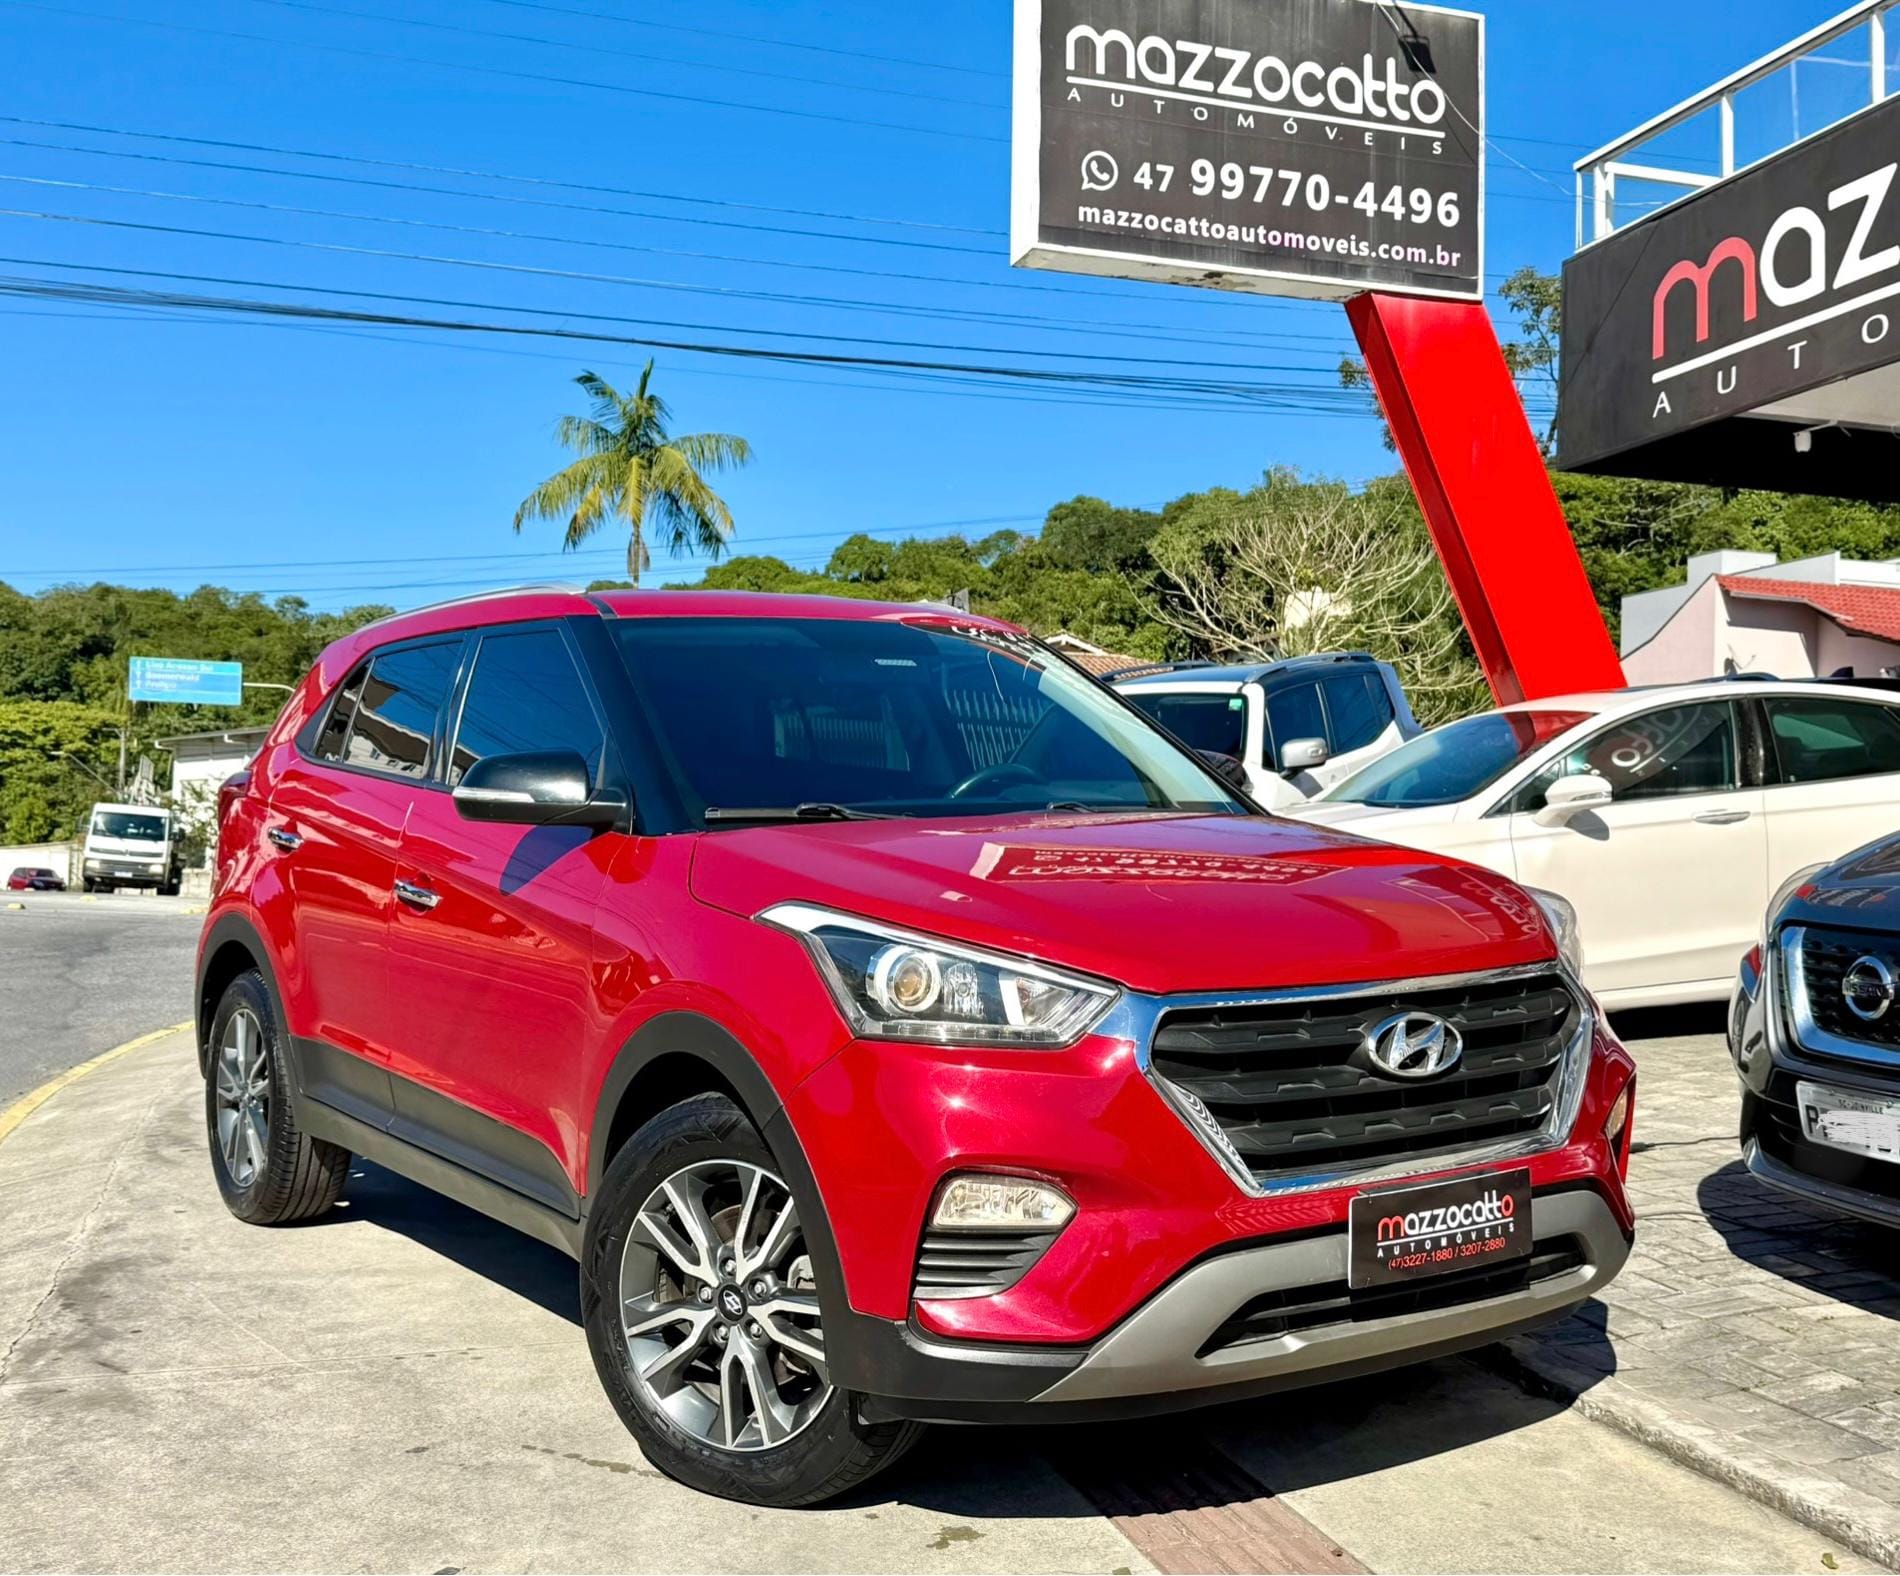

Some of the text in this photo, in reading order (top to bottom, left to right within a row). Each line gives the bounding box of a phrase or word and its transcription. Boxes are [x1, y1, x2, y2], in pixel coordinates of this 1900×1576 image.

[1066, 24, 1446, 124] mazzocatto
[1067, 87, 1443, 155] AUTOMÓVEIS
[1133, 158, 1461, 228] 47 99770-4496
[1078, 204, 1461, 268] mazzocattoautomoveis.com.br
[1377, 1190, 1514, 1241] mazzocatto
[1377, 1222, 1515, 1258] AUTOMÓVEIS
